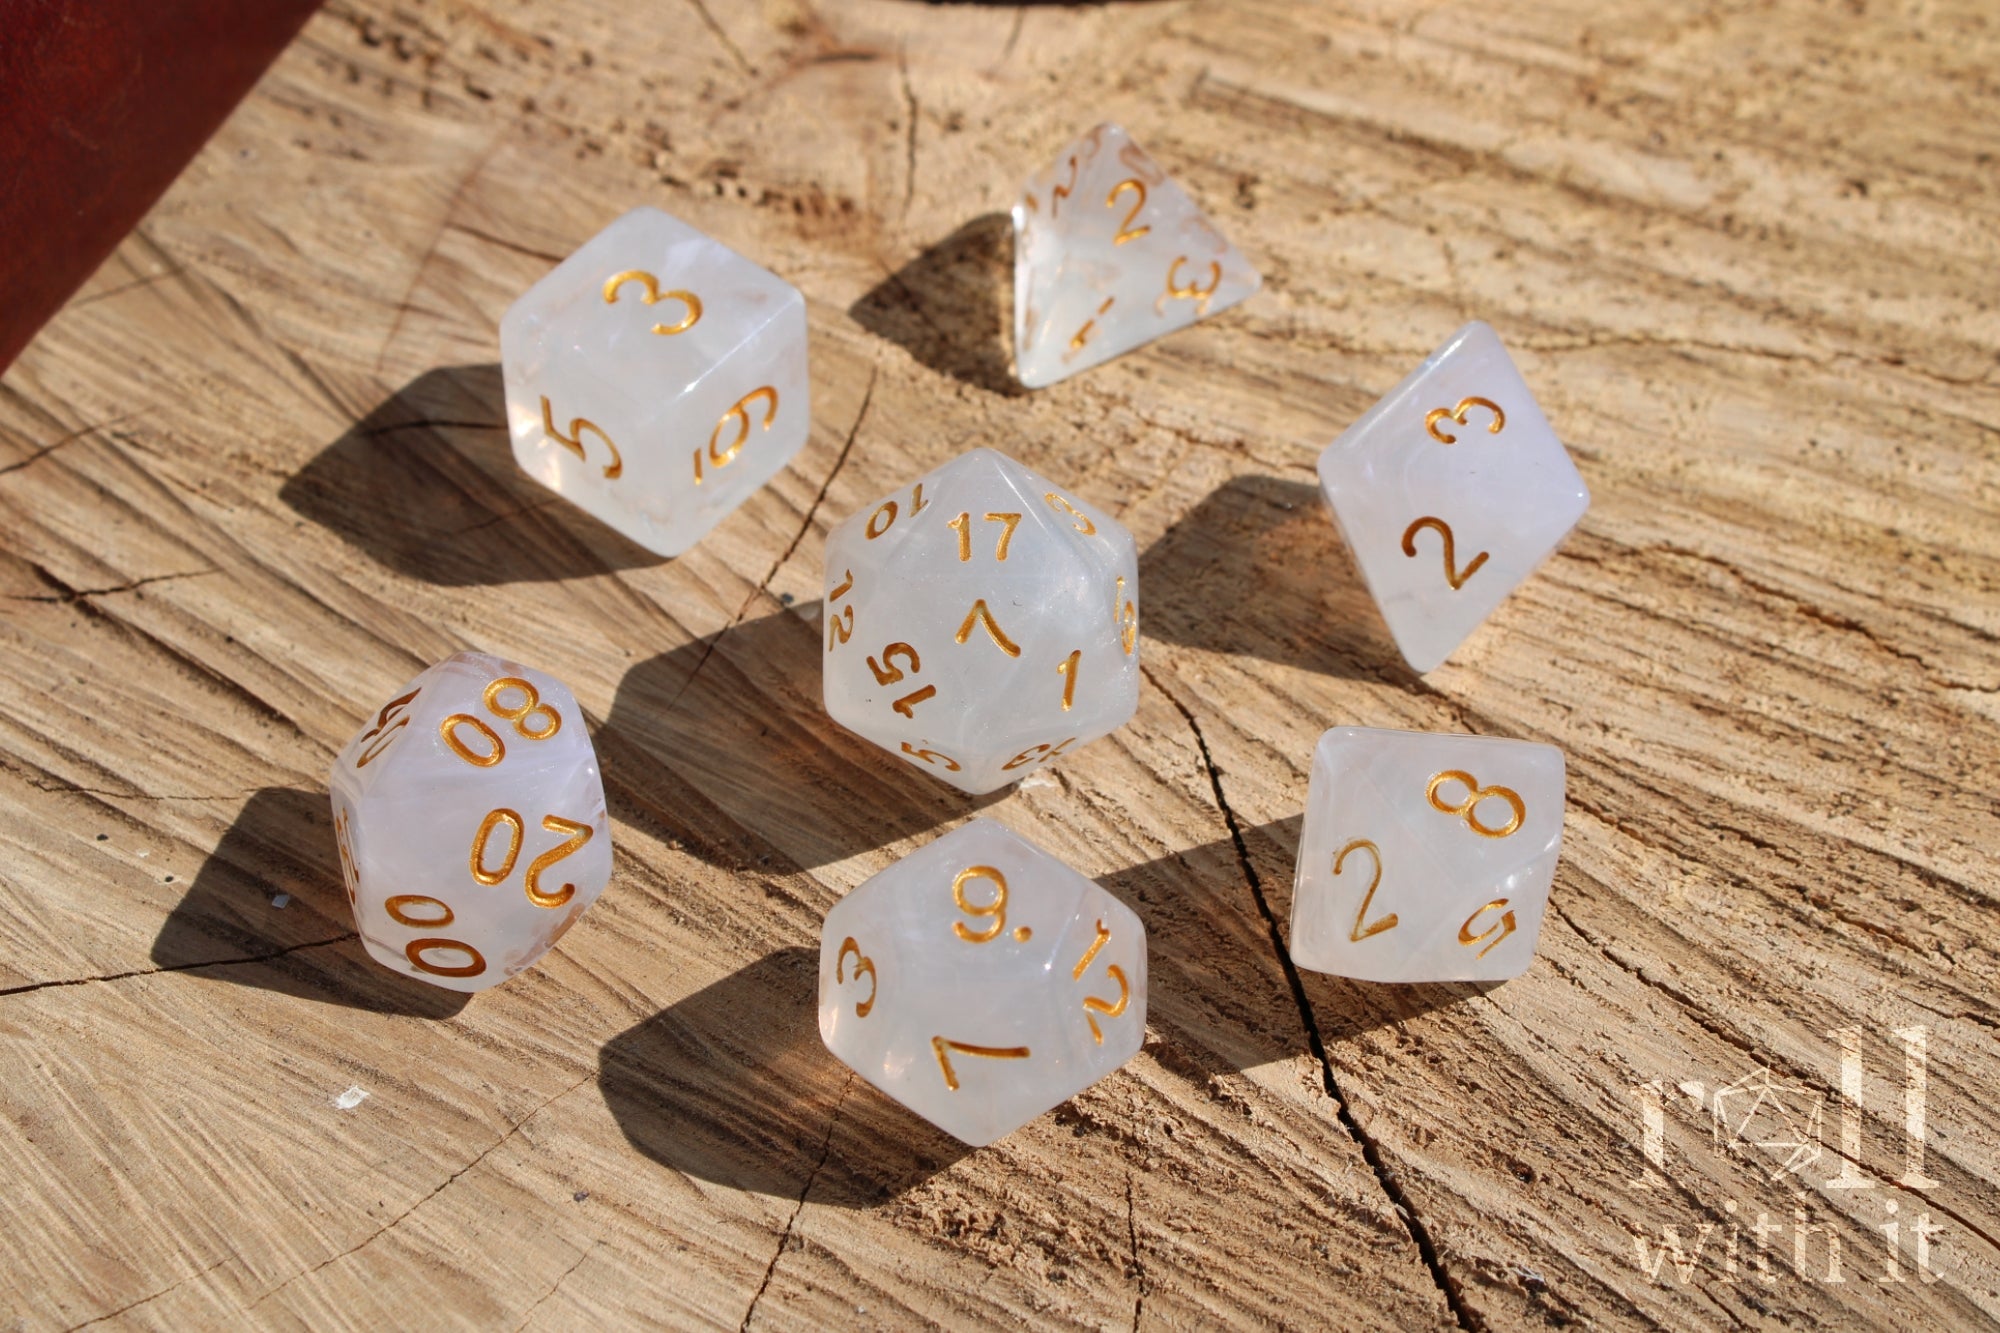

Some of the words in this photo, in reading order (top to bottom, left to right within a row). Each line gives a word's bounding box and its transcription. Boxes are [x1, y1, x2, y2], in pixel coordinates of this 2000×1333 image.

[1106, 179, 1152, 246] 2
[602, 269, 703, 336] 3
[1166, 255, 1222, 300] 3
[540, 394, 622, 480] 5
[1424, 396, 1506, 445] 3
[864, 482, 929, 541] 10
[946, 511, 1022, 562] 17
[1044, 492, 1097, 537] 3
[1401, 515, 1490, 591] 2
[828, 568, 854, 652] 12
[954, 598, 1022, 659] 7
[866, 641, 937, 720] 15
[1056, 649, 1082, 713] 1
[439, 676, 563, 769] 80
[1001, 737, 1077, 772] 13
[900, 741, 962, 772] 5
[1423, 769, 1526, 839] 8
[469, 807, 594, 910] 20
[1331, 838, 1399, 943] 2
[384, 894, 487, 979] 00
[1457, 897, 1518, 961] 5
[836, 936, 878, 1018] 3
[1072, 917, 1130, 1045] 12
[931, 1035, 1031, 1091] 7
